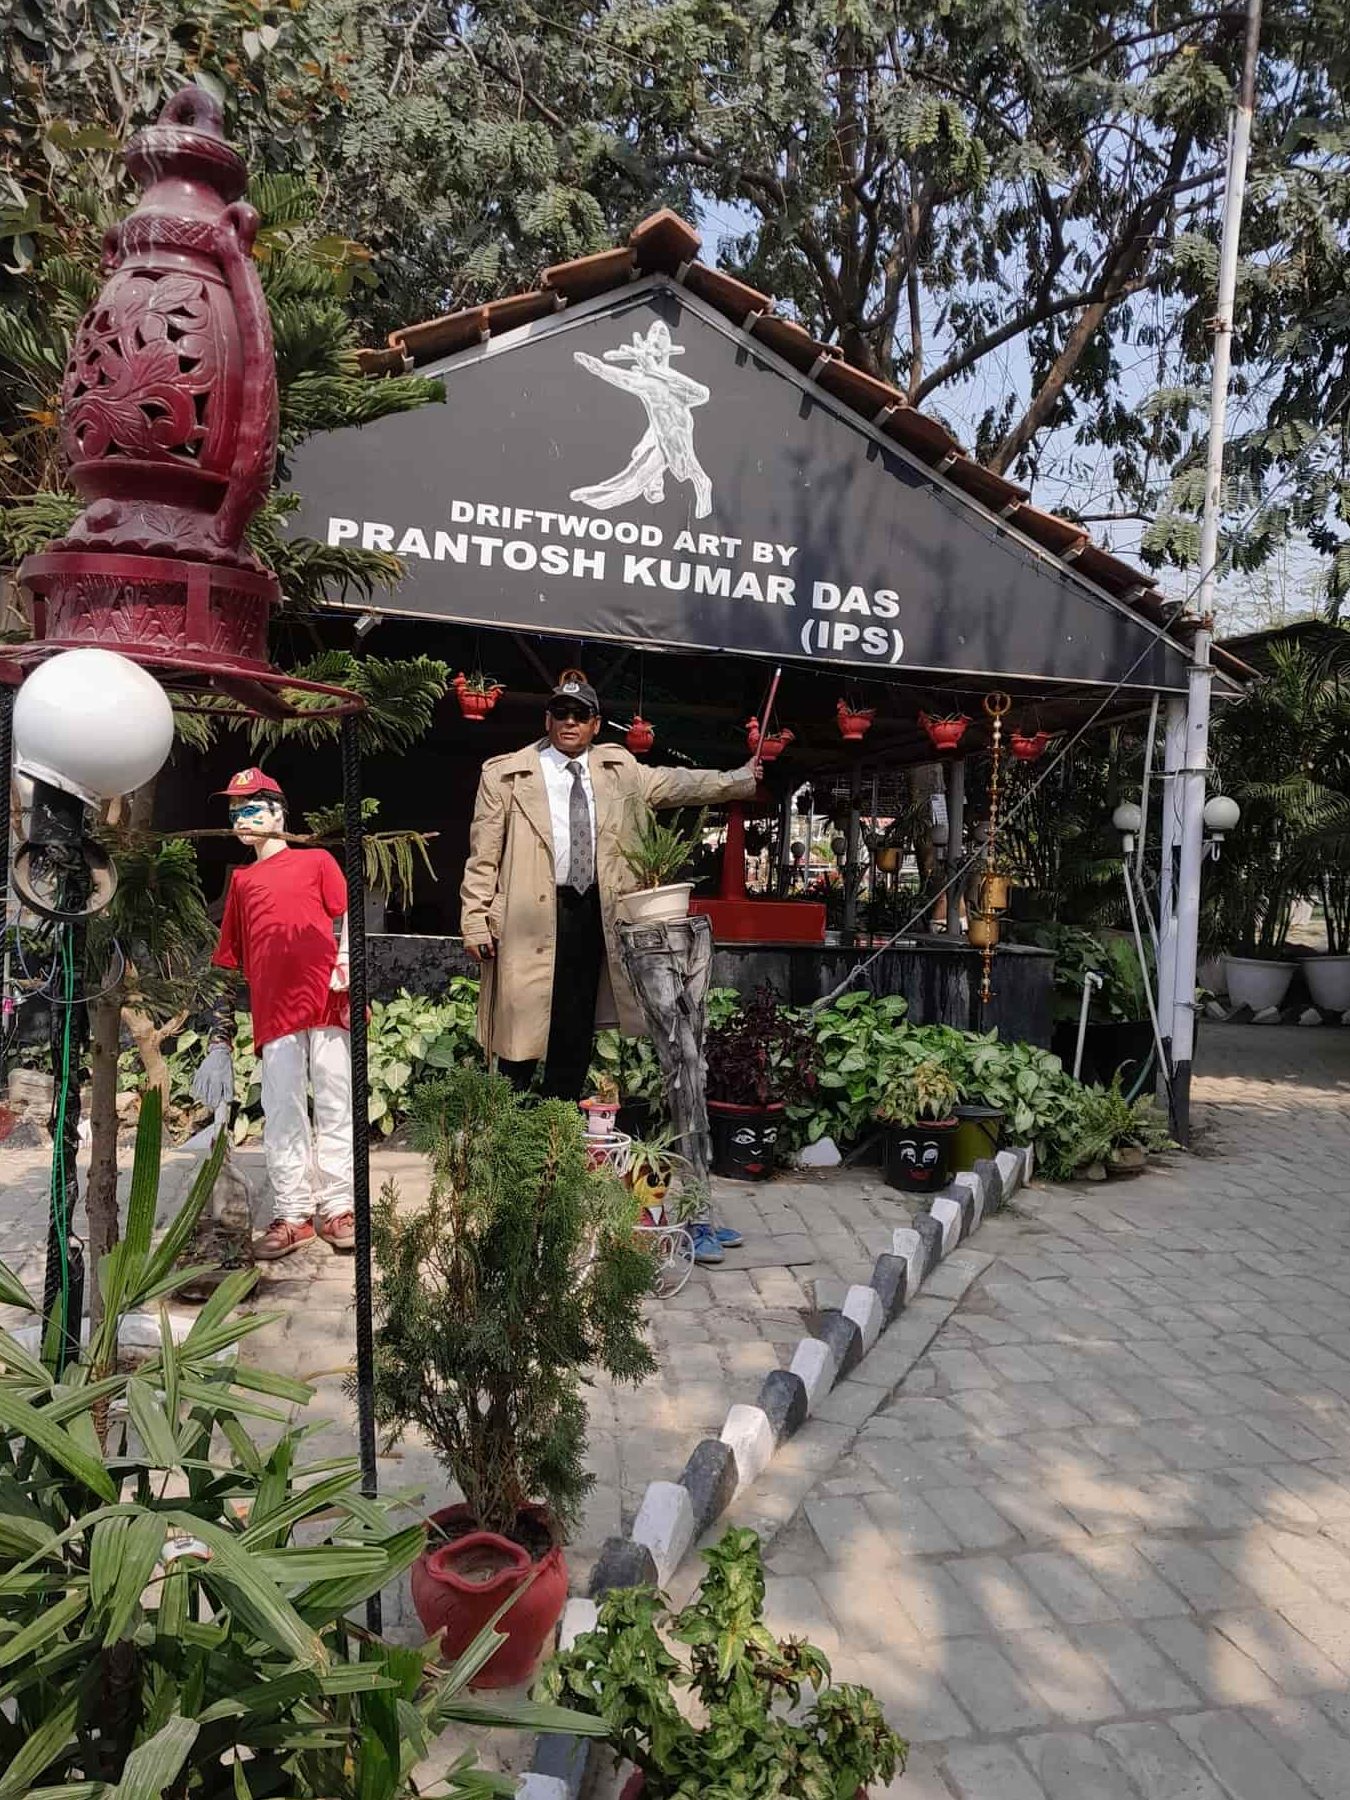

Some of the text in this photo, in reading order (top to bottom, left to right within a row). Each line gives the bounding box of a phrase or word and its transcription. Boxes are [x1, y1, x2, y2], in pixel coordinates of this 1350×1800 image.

[451, 499, 798, 566] DRIFTWOOD ART BY
[327, 517, 901, 619] PRANTOSH KUMAR DAS
[801, 619, 905, 664] (IPS)
